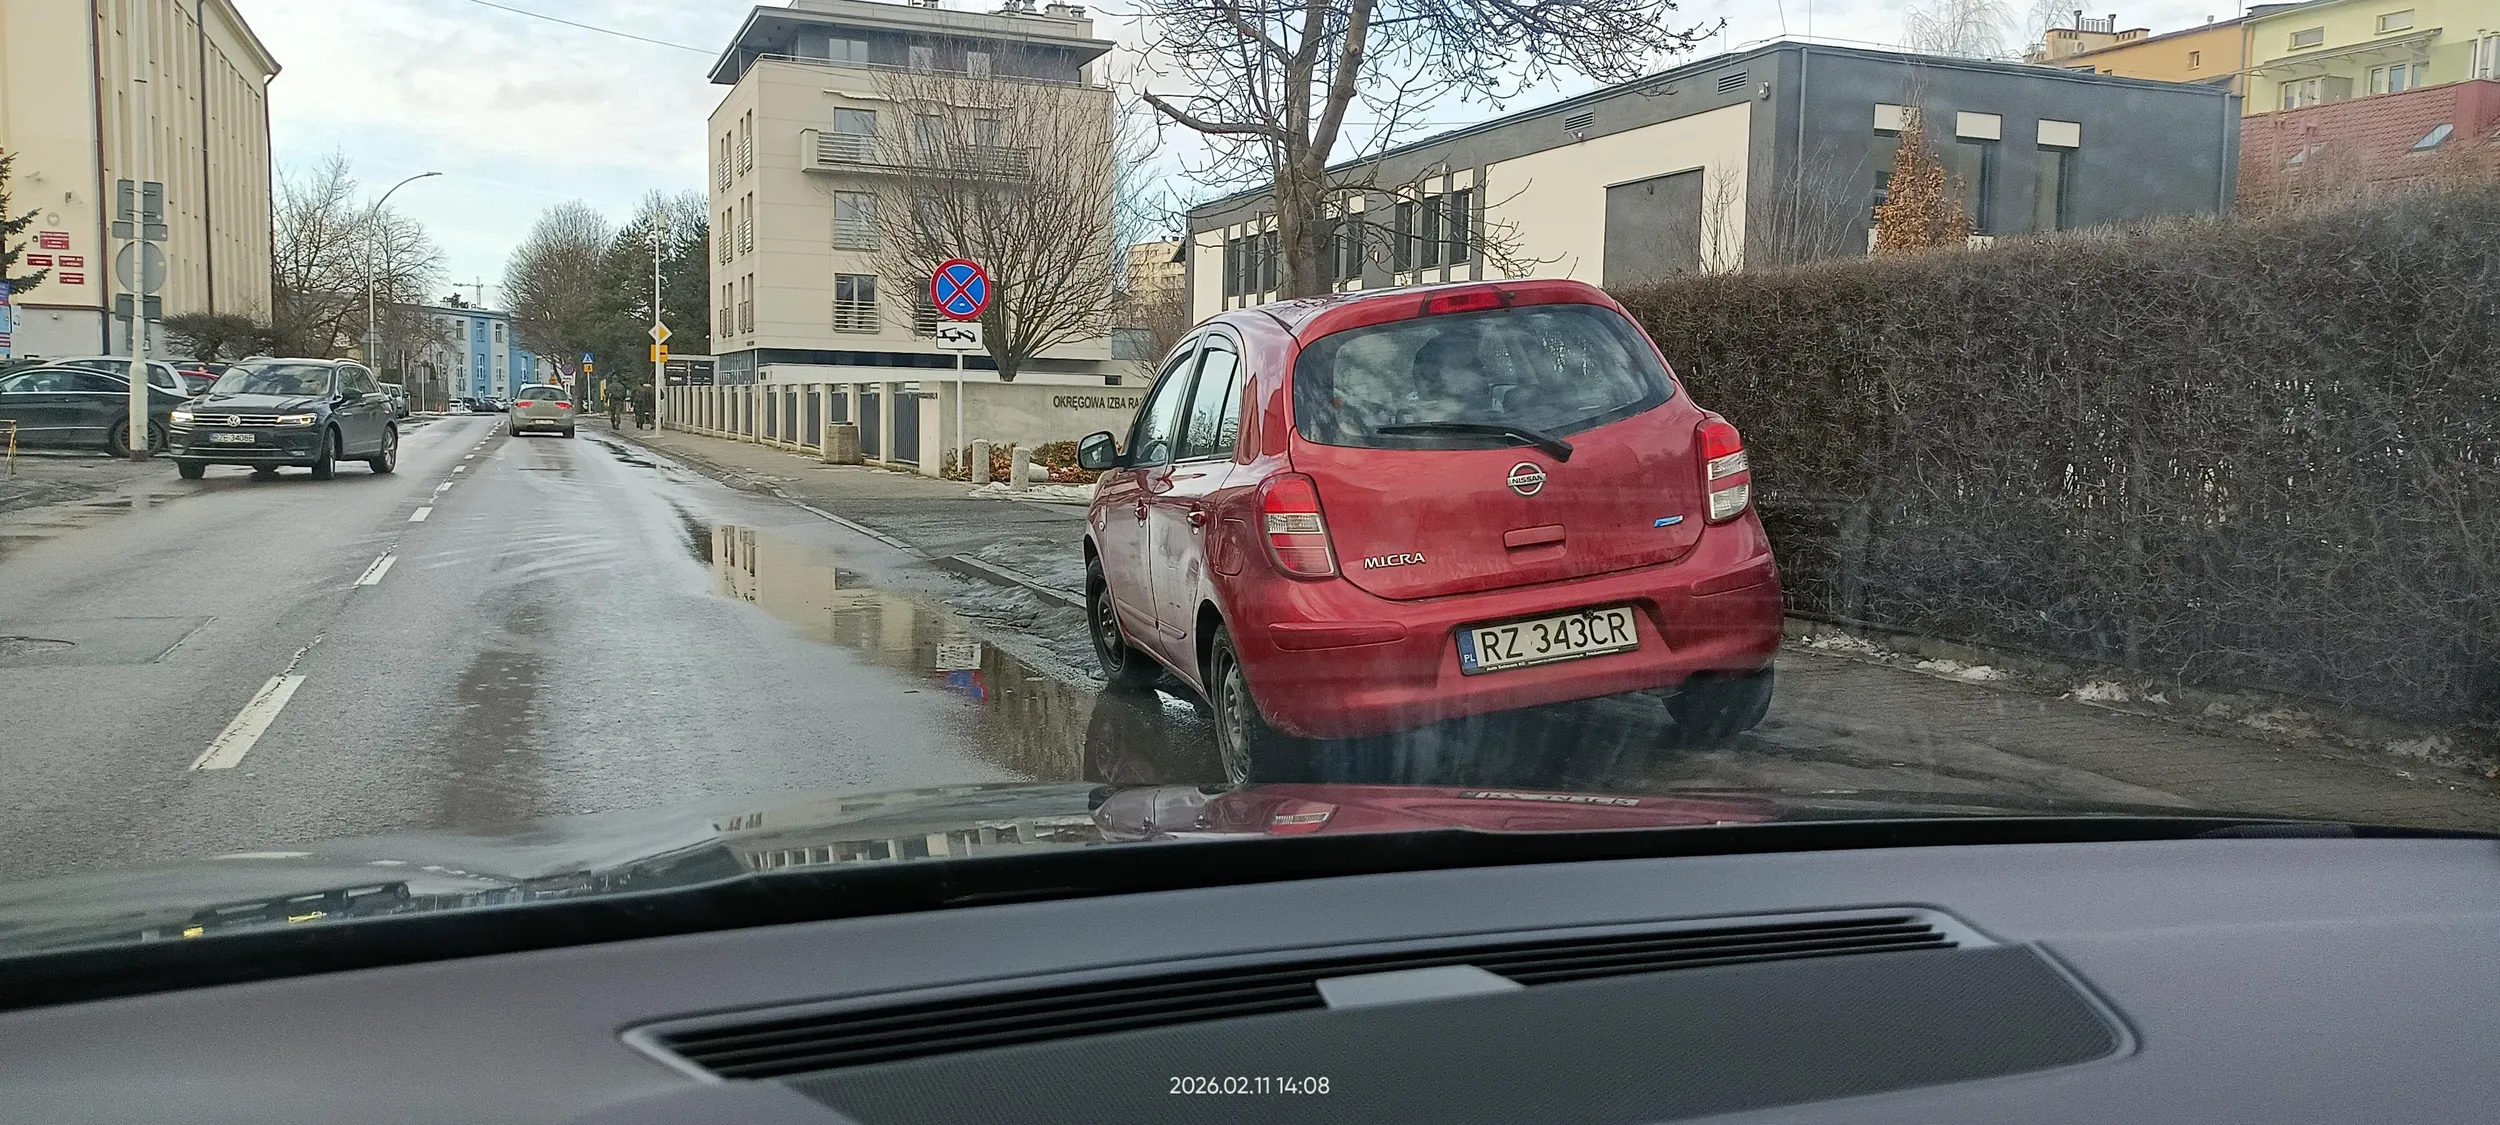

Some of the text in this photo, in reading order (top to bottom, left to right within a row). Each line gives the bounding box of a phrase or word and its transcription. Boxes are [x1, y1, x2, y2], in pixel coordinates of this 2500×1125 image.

[1053, 395, 1142, 411] OKRĘGOWA IZBA RA
[1511, 474, 1543, 484] NISSAN
[1364, 552, 1426, 569] MICRA
[1480, 612, 1629, 662] RZ 343CR
[1464, 654, 1476, 663] PL
